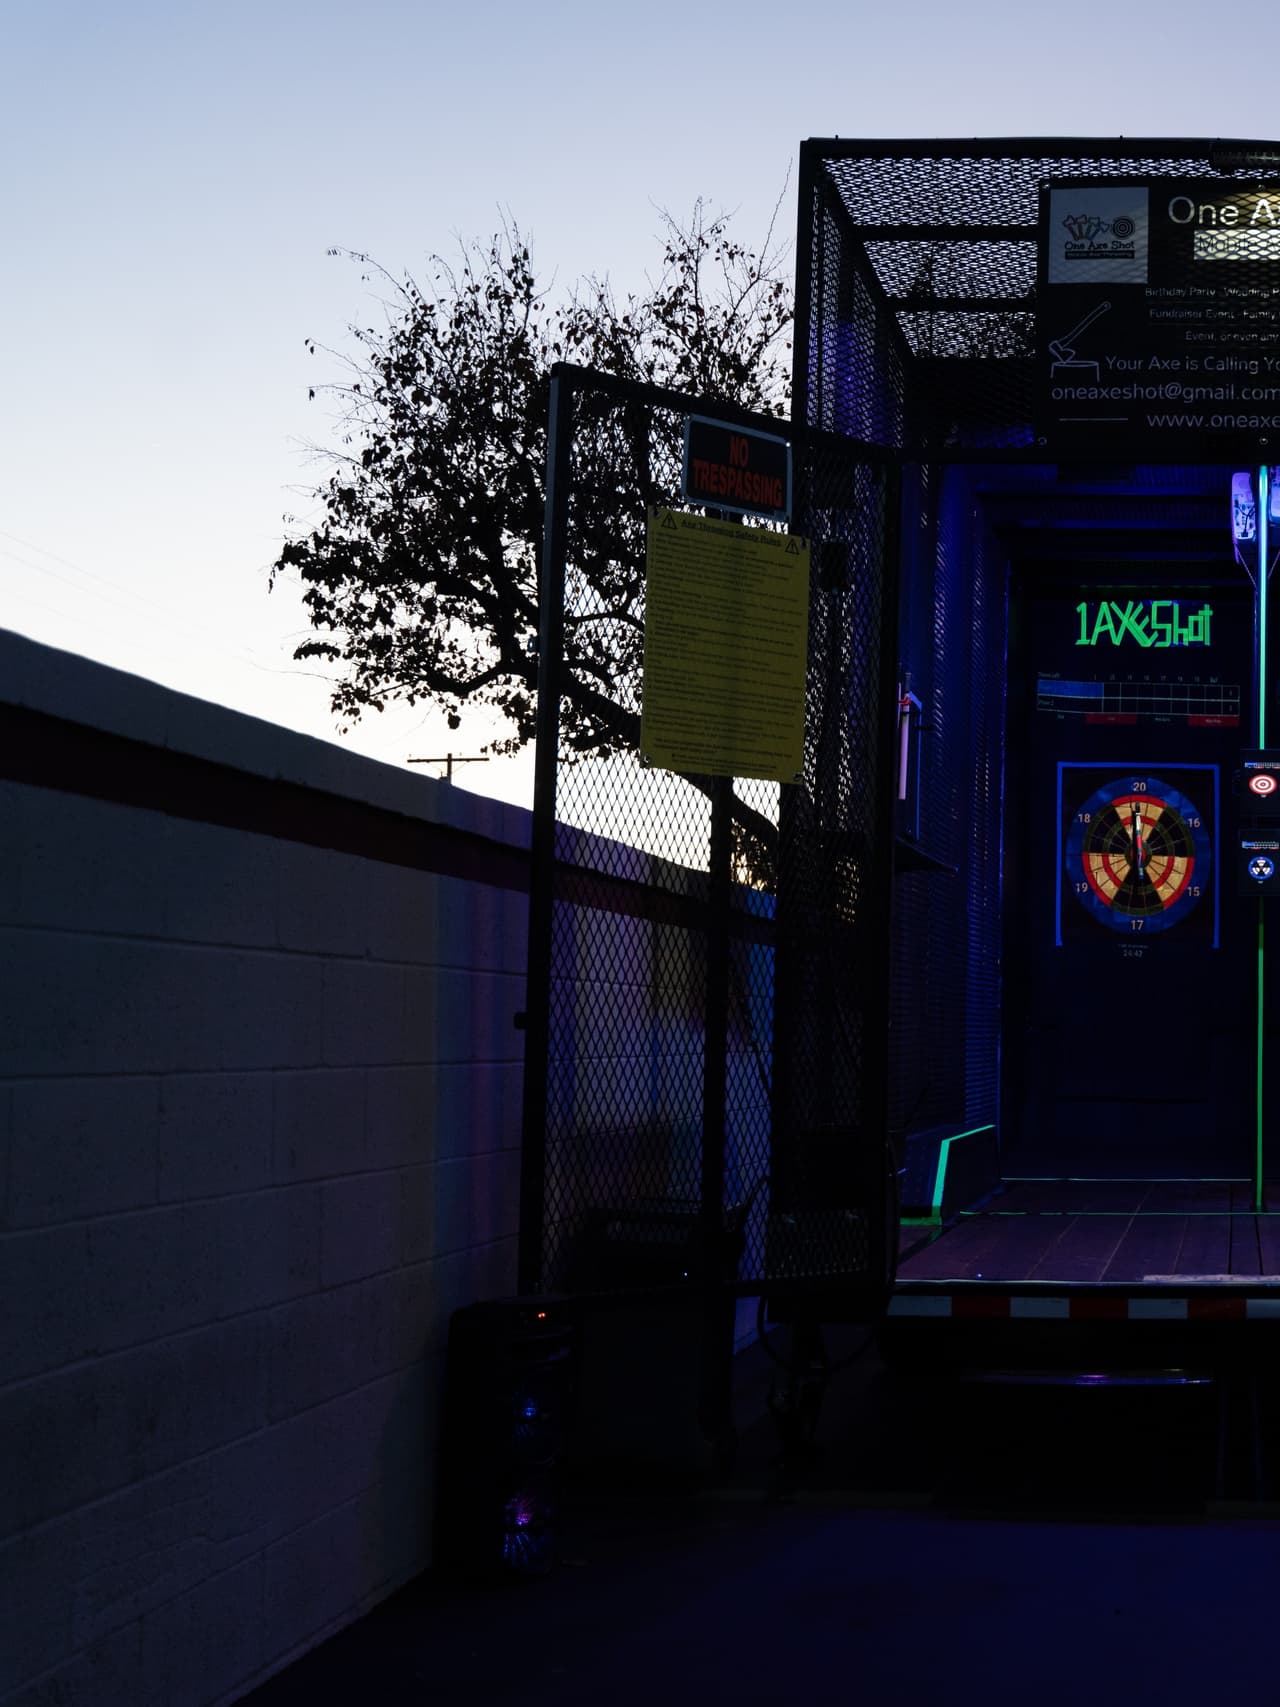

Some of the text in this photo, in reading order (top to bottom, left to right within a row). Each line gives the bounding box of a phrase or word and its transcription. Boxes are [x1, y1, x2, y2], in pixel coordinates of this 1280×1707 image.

[1168, 195, 1239, 226] One
[1064, 239, 1135, 250] One Axe Shot
[1144, 287, 1185, 298] Birthday
[1190, 287, 1215, 298] Party
[1149, 308, 1202, 319] Fundraiser
[1105, 354, 1145, 371] Your
[1148, 355, 1182, 371] Axe
[1185, 355, 1198, 371] is
[1203, 355, 1260, 375] Calling
[729, 435, 750, 467] NO
[691, 458, 784, 508] TRESPASSING
[1132, 782, 1147, 792] 20
[1078, 813, 1091, 823] 18
[1187, 818, 1201, 828] 16
[1075, 882, 1089, 893] 19
[1187, 887, 1201, 896] 15
[1131, 920, 1144, 930] 17
